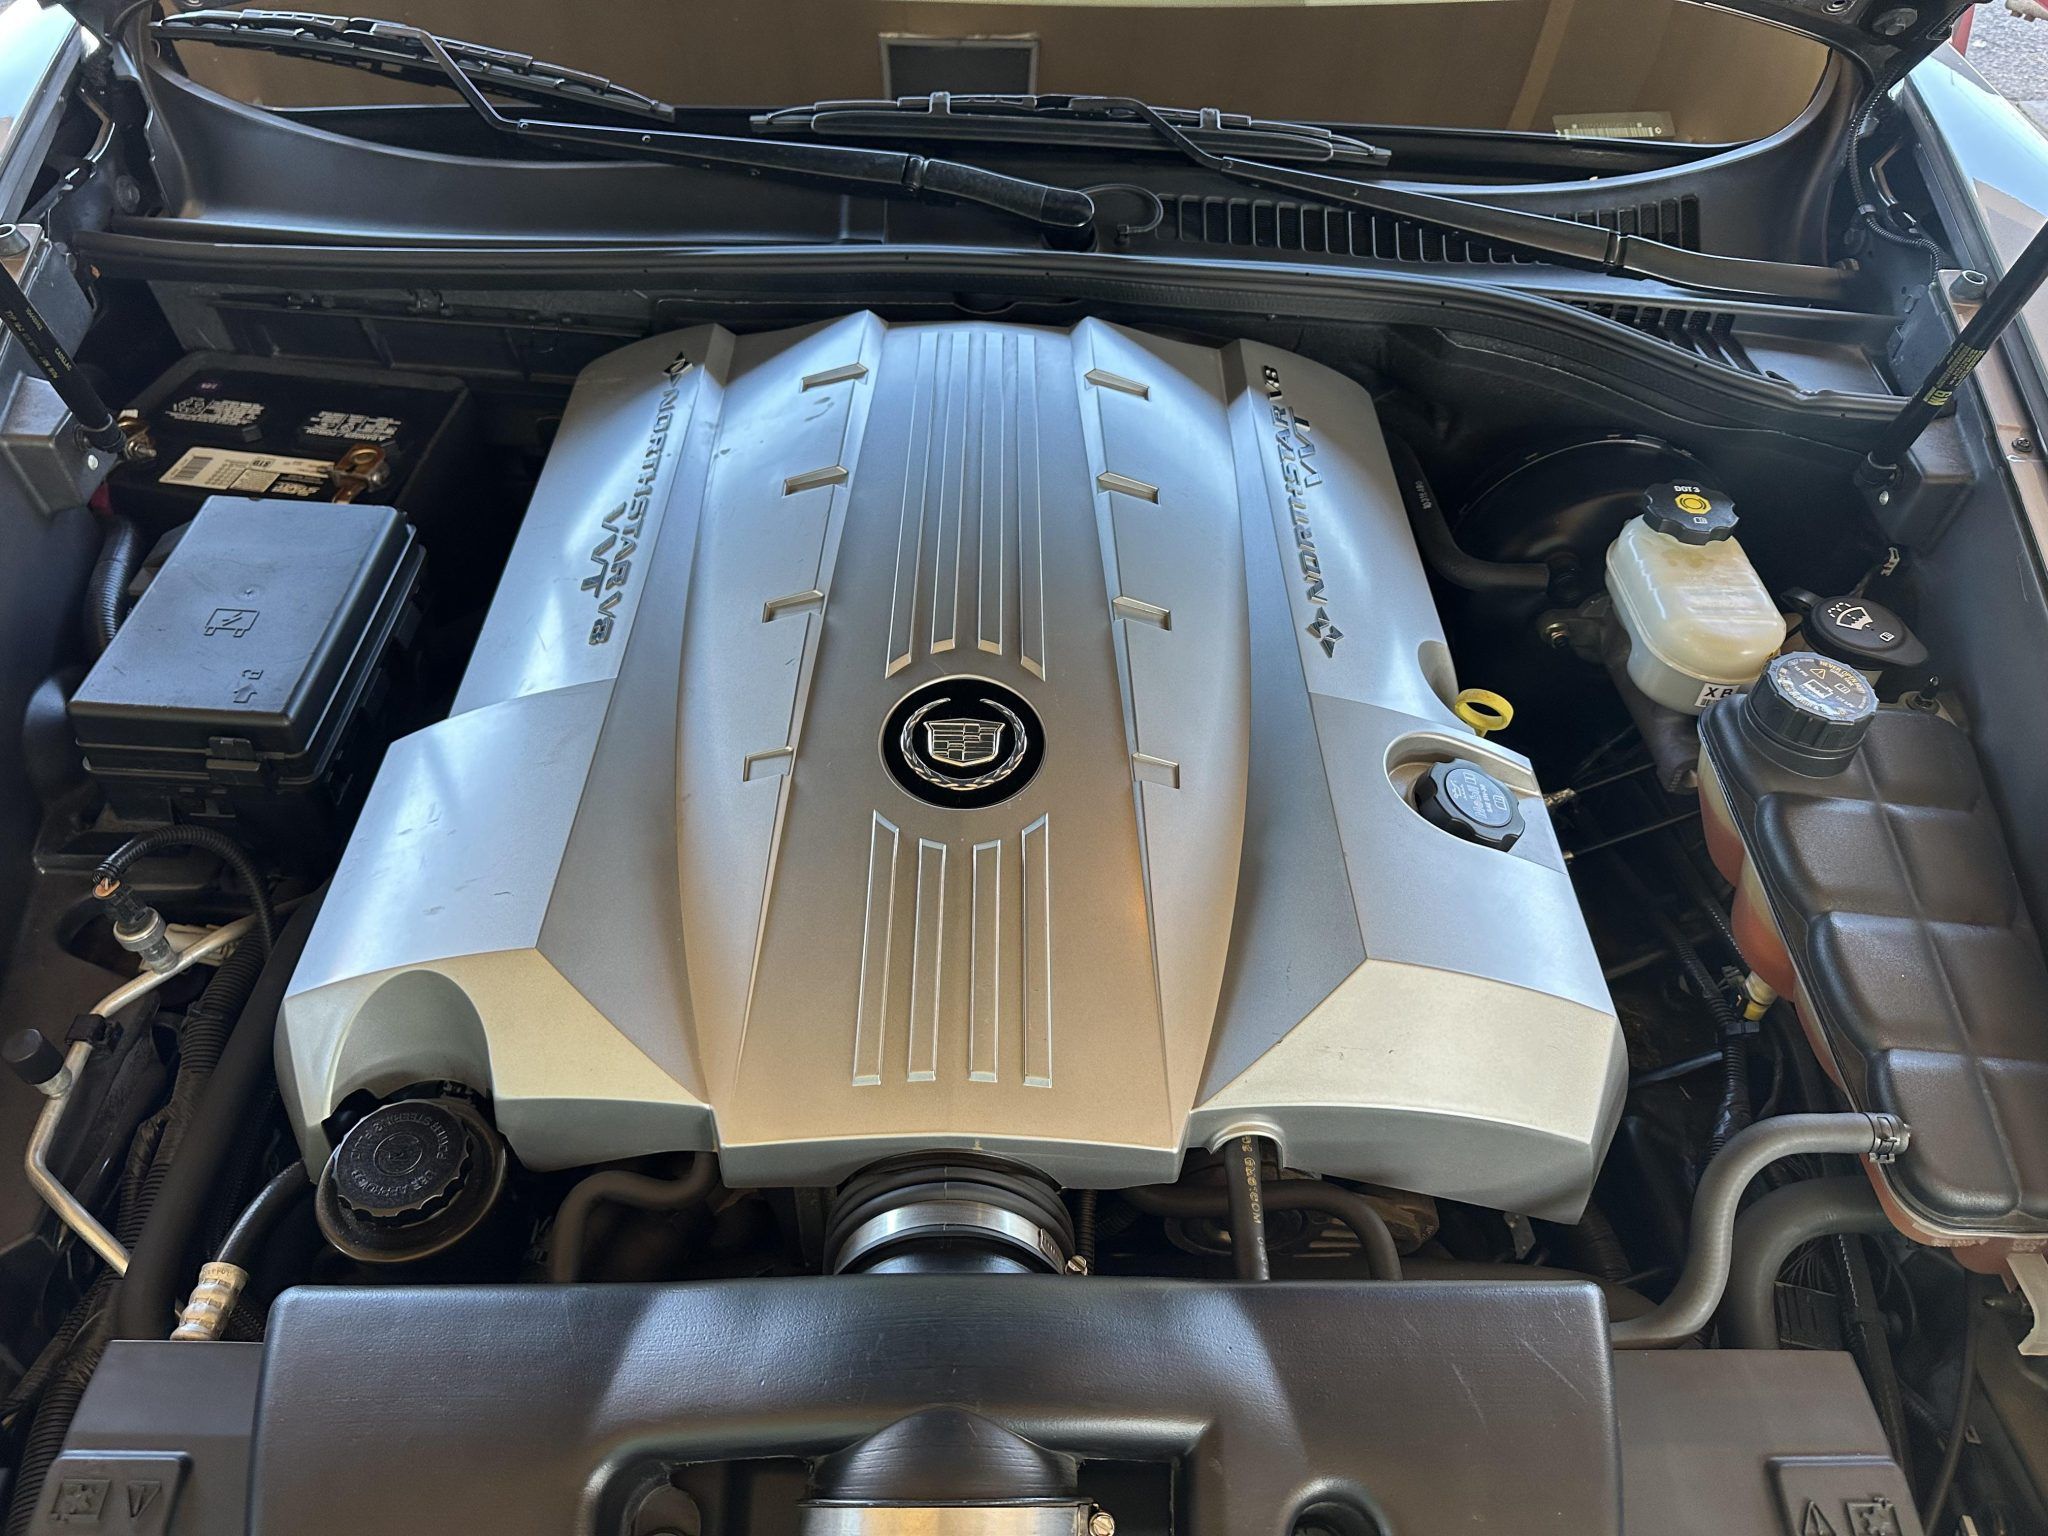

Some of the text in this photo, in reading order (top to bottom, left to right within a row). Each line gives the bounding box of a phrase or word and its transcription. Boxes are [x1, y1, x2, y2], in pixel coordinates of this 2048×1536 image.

[54, 347, 72, 371] CADILLAC
[1262, 364, 1328, 605] NORTHSTAR V8
[1288, 406, 1323, 489] VVT
[1673, 485, 1693, 493] DOT
[580, 501, 628, 598] VVT
[588, 389, 680, 645] NORTHSTAR V8
[1819, 660, 1844, 675] NEVER
[1843, 669, 1857, 684] OPEN
